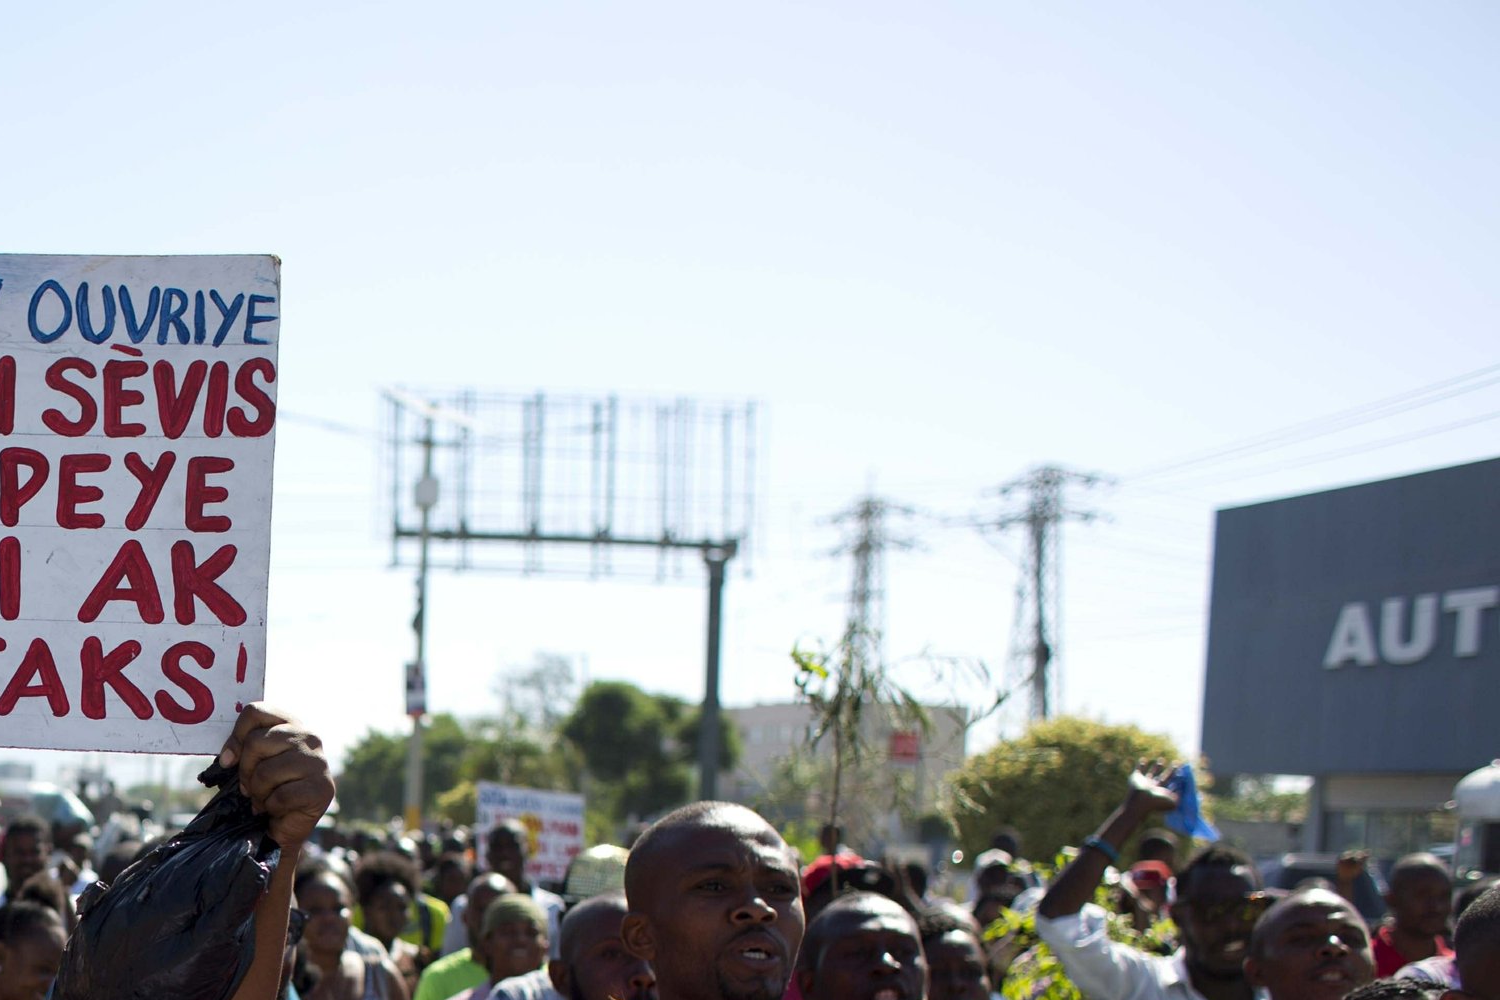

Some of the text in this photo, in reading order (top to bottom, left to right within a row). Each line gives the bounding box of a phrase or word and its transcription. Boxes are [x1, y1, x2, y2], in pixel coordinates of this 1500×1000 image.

[27, 278, 278, 347] OUVRIYE
[41, 344, 276, 438] SÈVIS
[77, 539, 248, 627] AK
[1322, 585, 1499, 670] AUT
